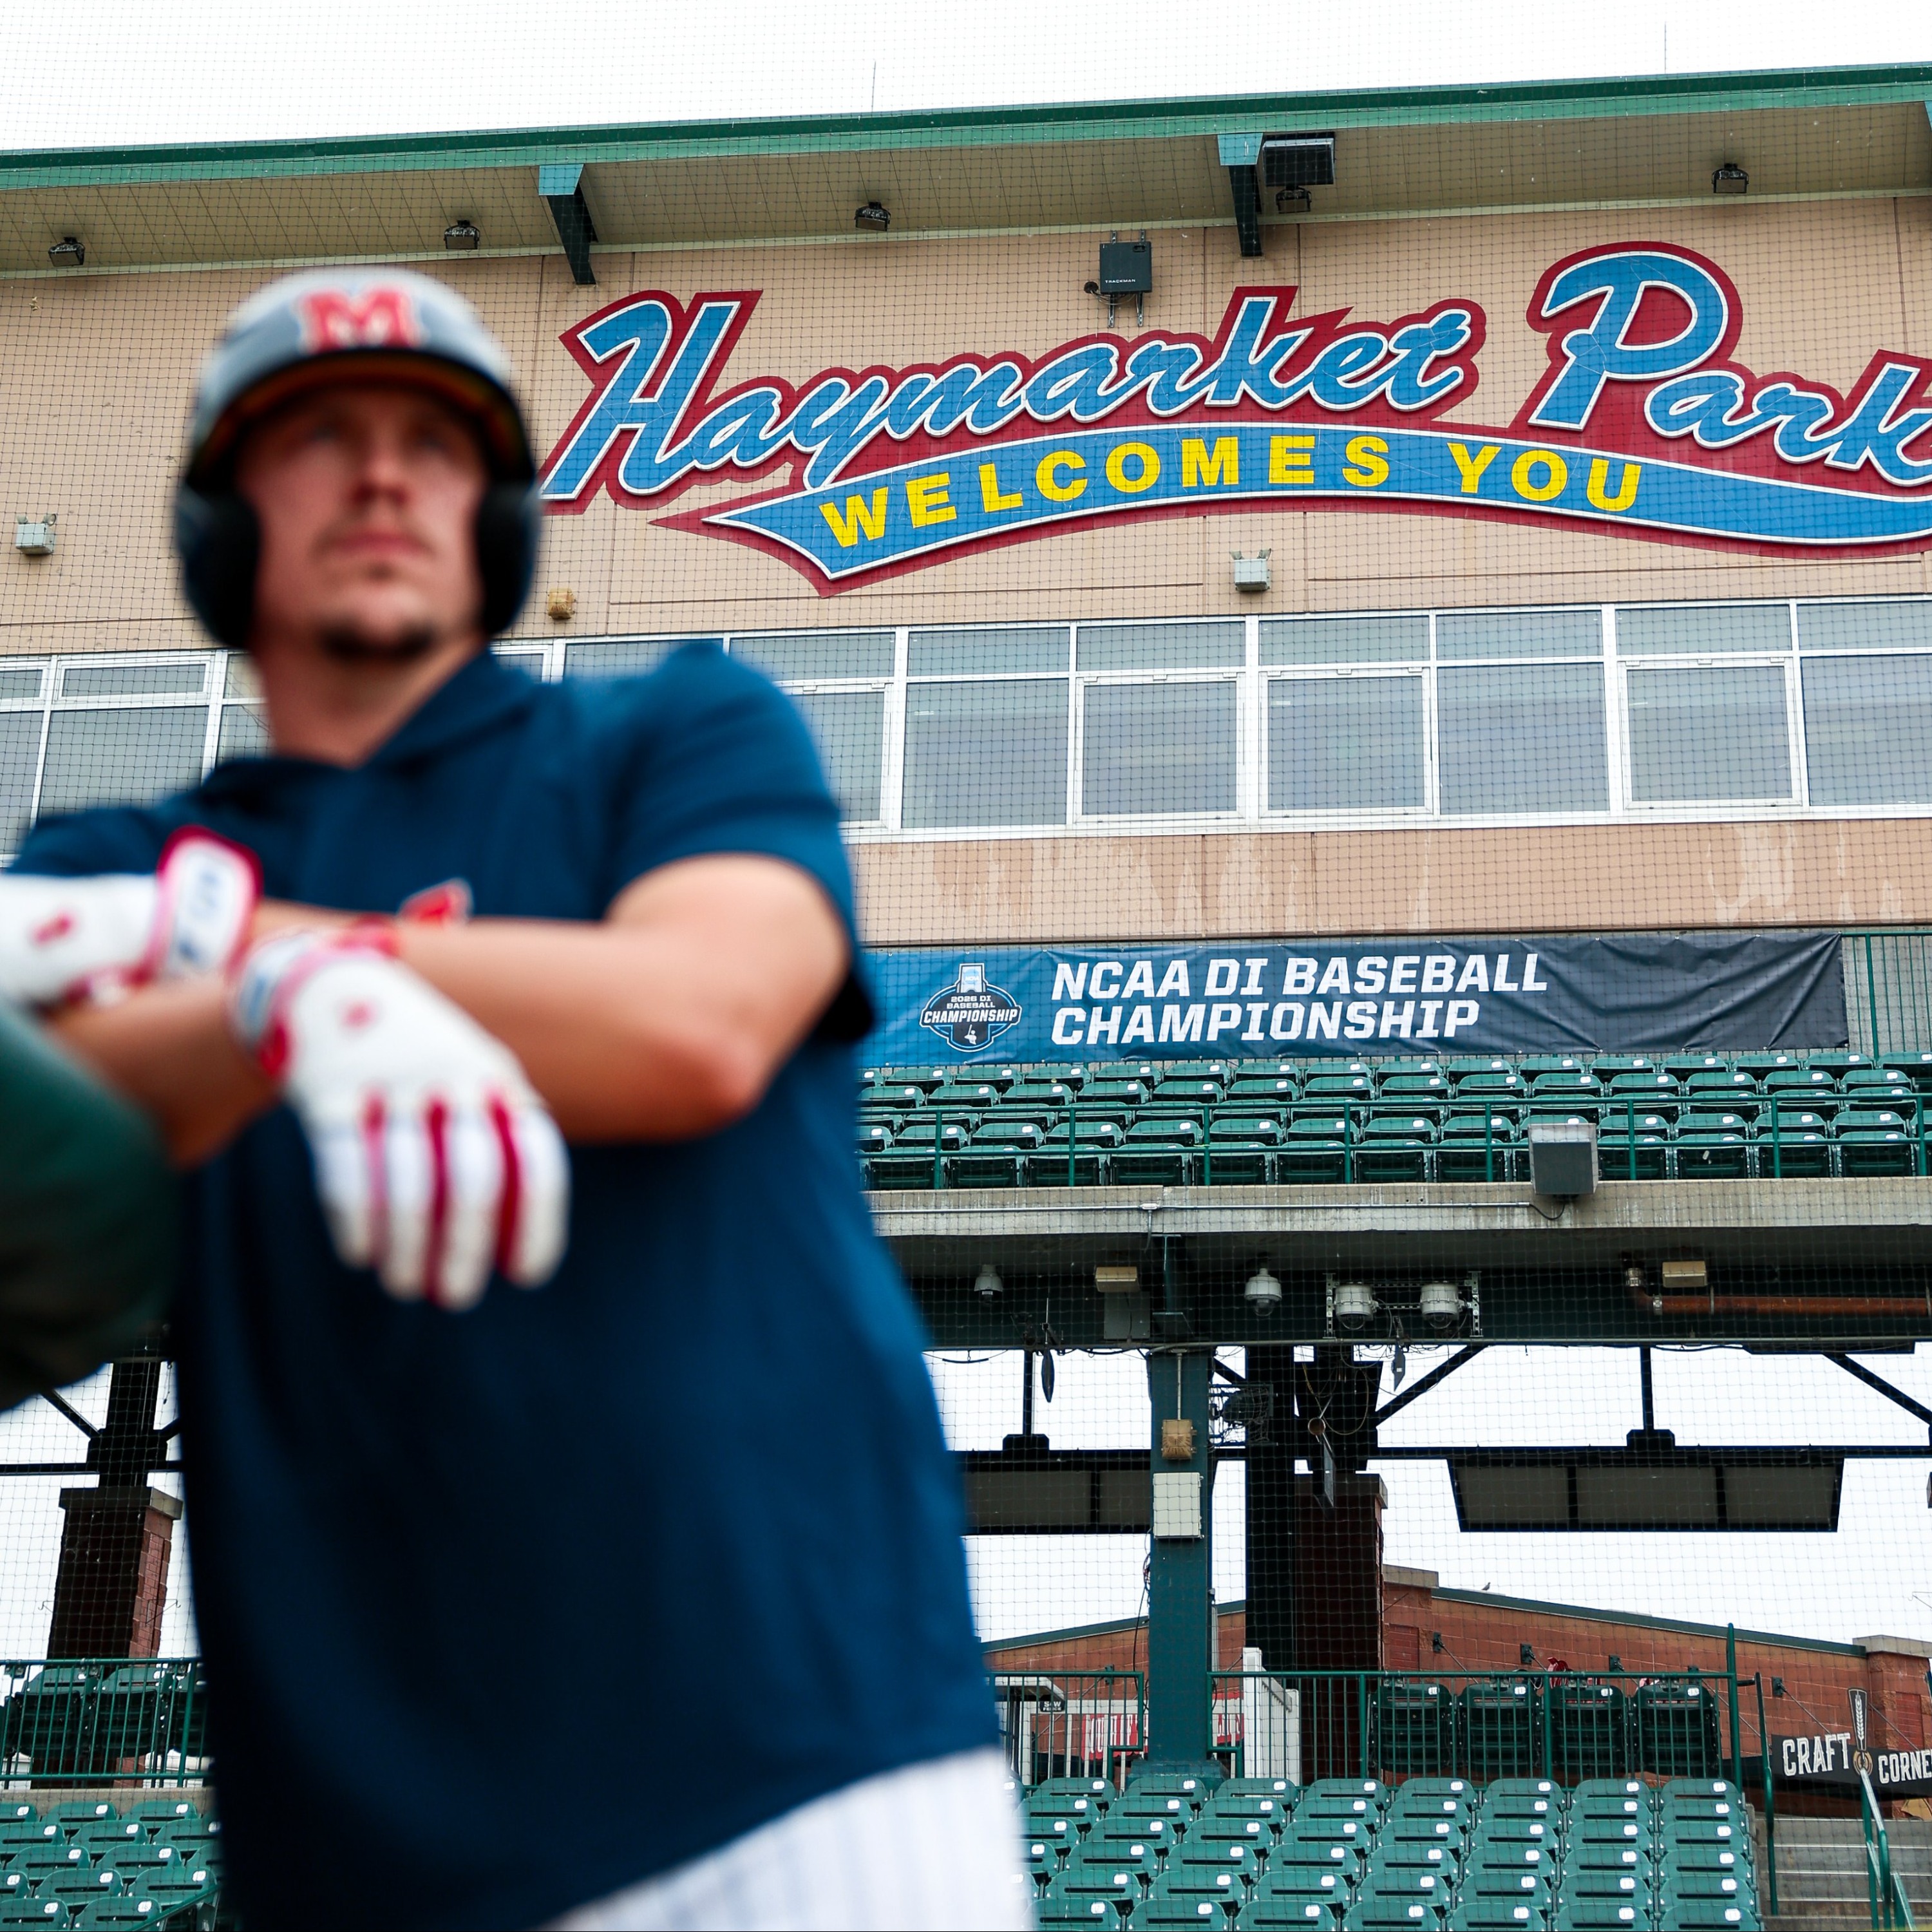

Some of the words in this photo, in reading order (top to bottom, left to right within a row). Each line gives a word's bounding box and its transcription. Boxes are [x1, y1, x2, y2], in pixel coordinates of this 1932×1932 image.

[299, 283, 421, 354] M
[540, 296, 1472, 496] Haymarket
[1528, 251, 1932, 487] Park
[819, 436, 1389, 547] WELCOMES
[1446, 442, 1642, 512] YOU
[1052, 960, 1191, 1001] NCAA
[1204, 958, 1269, 997] DI
[1282, 953, 1548, 996] BASEBALL
[923, 1009, 1018, 1023] CHAMPIONSHIP
[1051, 1000, 1480, 1045] CHAMPIONSHIP
[1783, 1732, 1850, 1776] CRAFT
[1878, 1749, 1932, 1784] CORNE
